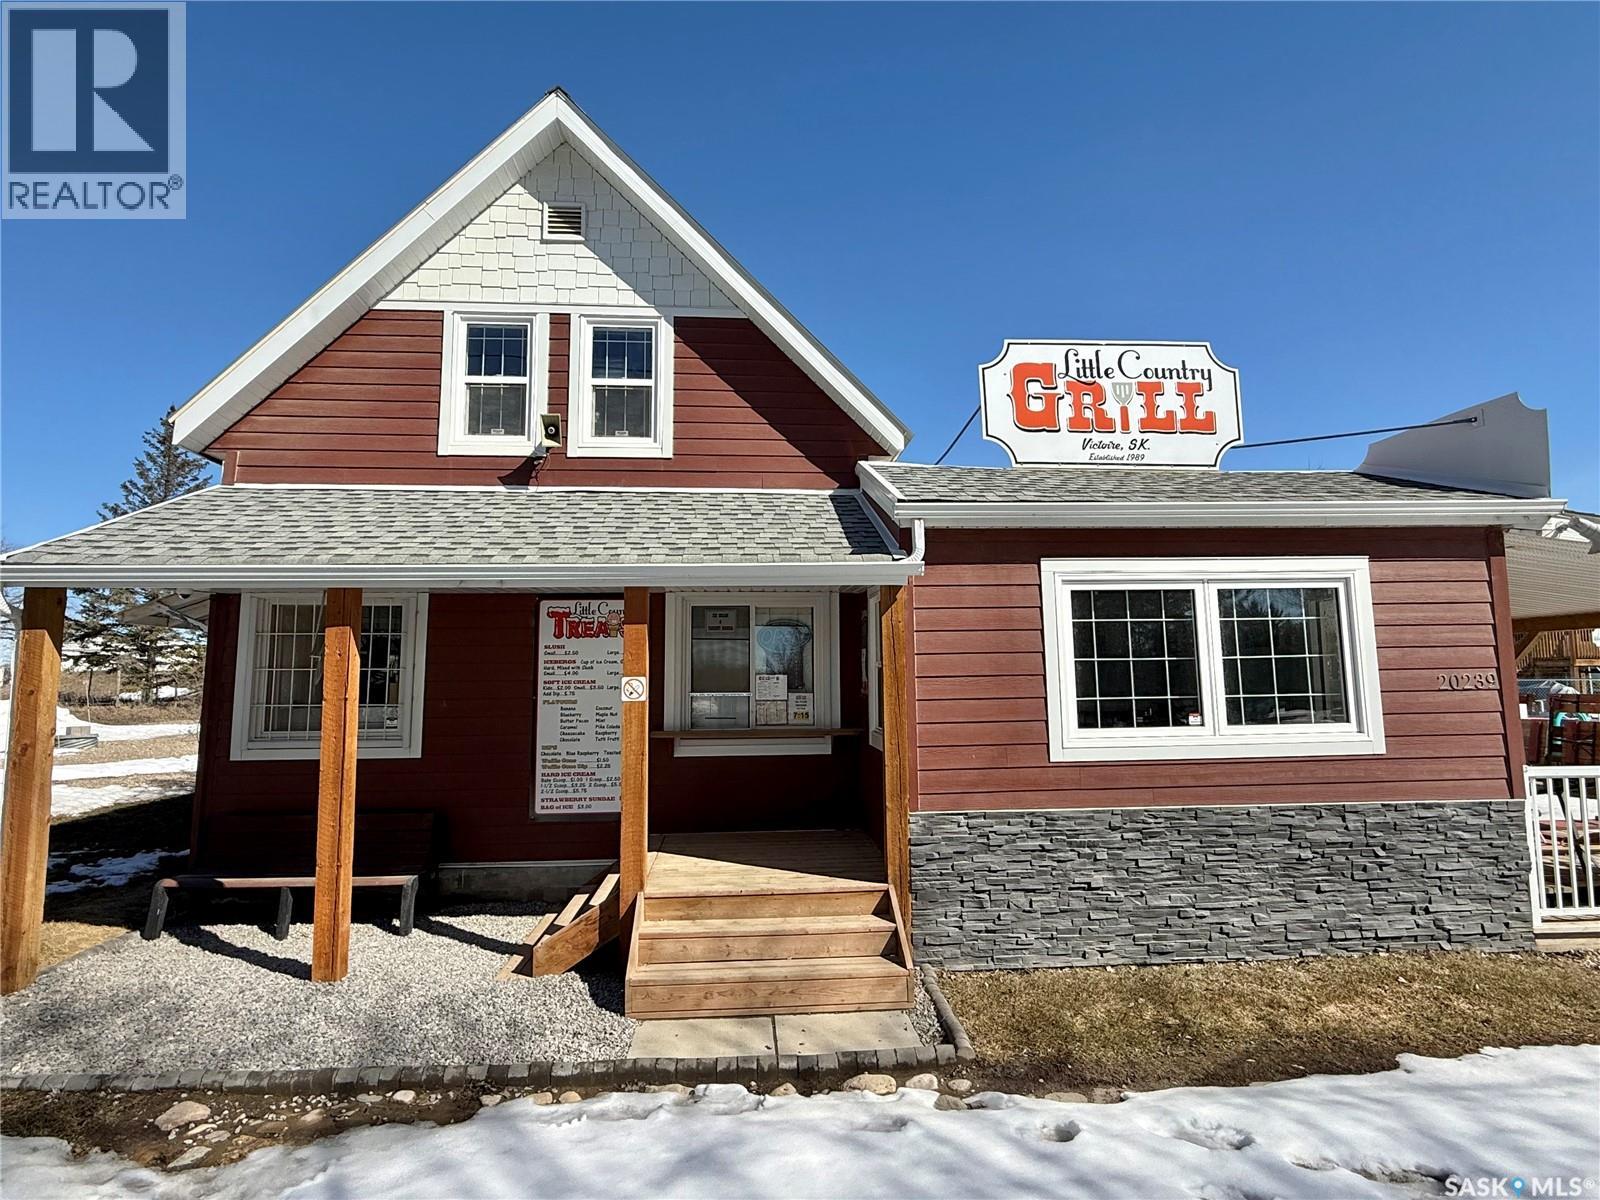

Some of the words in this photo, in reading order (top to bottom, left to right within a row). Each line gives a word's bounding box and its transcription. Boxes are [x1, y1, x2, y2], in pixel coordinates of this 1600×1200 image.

[1058, 349, 1115, 383] Little
[1118, 350, 1213, 391] Country
[1007, 363, 1217, 435] GRILL
[1082, 439, 1124, 451] Victoire,
[1129, 439, 1150, 451] SK.
[1089, 453, 1125, 461] Established
[573, 601, 596, 618] Little
[598, 602, 624, 615] Coun
